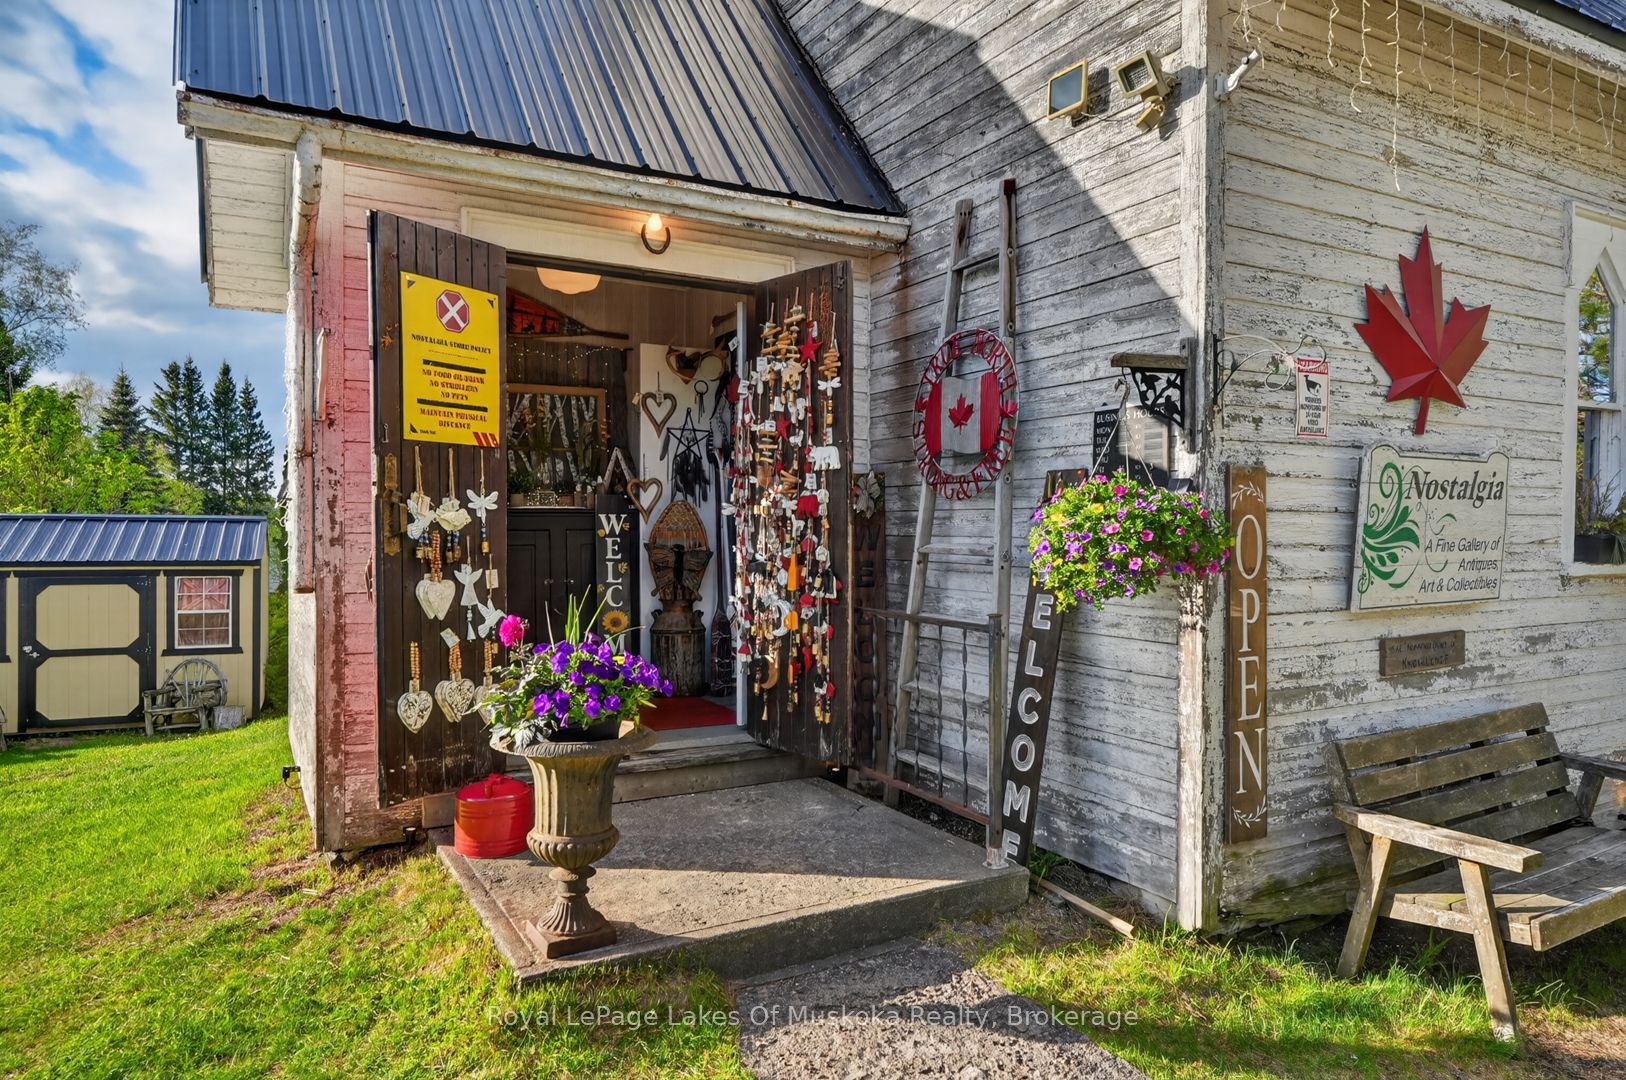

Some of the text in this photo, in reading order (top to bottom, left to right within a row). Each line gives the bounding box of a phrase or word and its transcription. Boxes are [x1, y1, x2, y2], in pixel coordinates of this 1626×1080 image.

[422, 368, 432, 376] NO
[434, 370, 452, 379] FOOD
[429, 379, 439, 387] NO
[1405, 470, 1505, 508] Nostalgia
[1425, 536, 1502, 555] A Fine Gallery of
[1418, 576, 1498, 594] Art & Collectibles
[1234, 514, 1266, 795] OPEN
[1002, 593, 1055, 864] ELCOME
